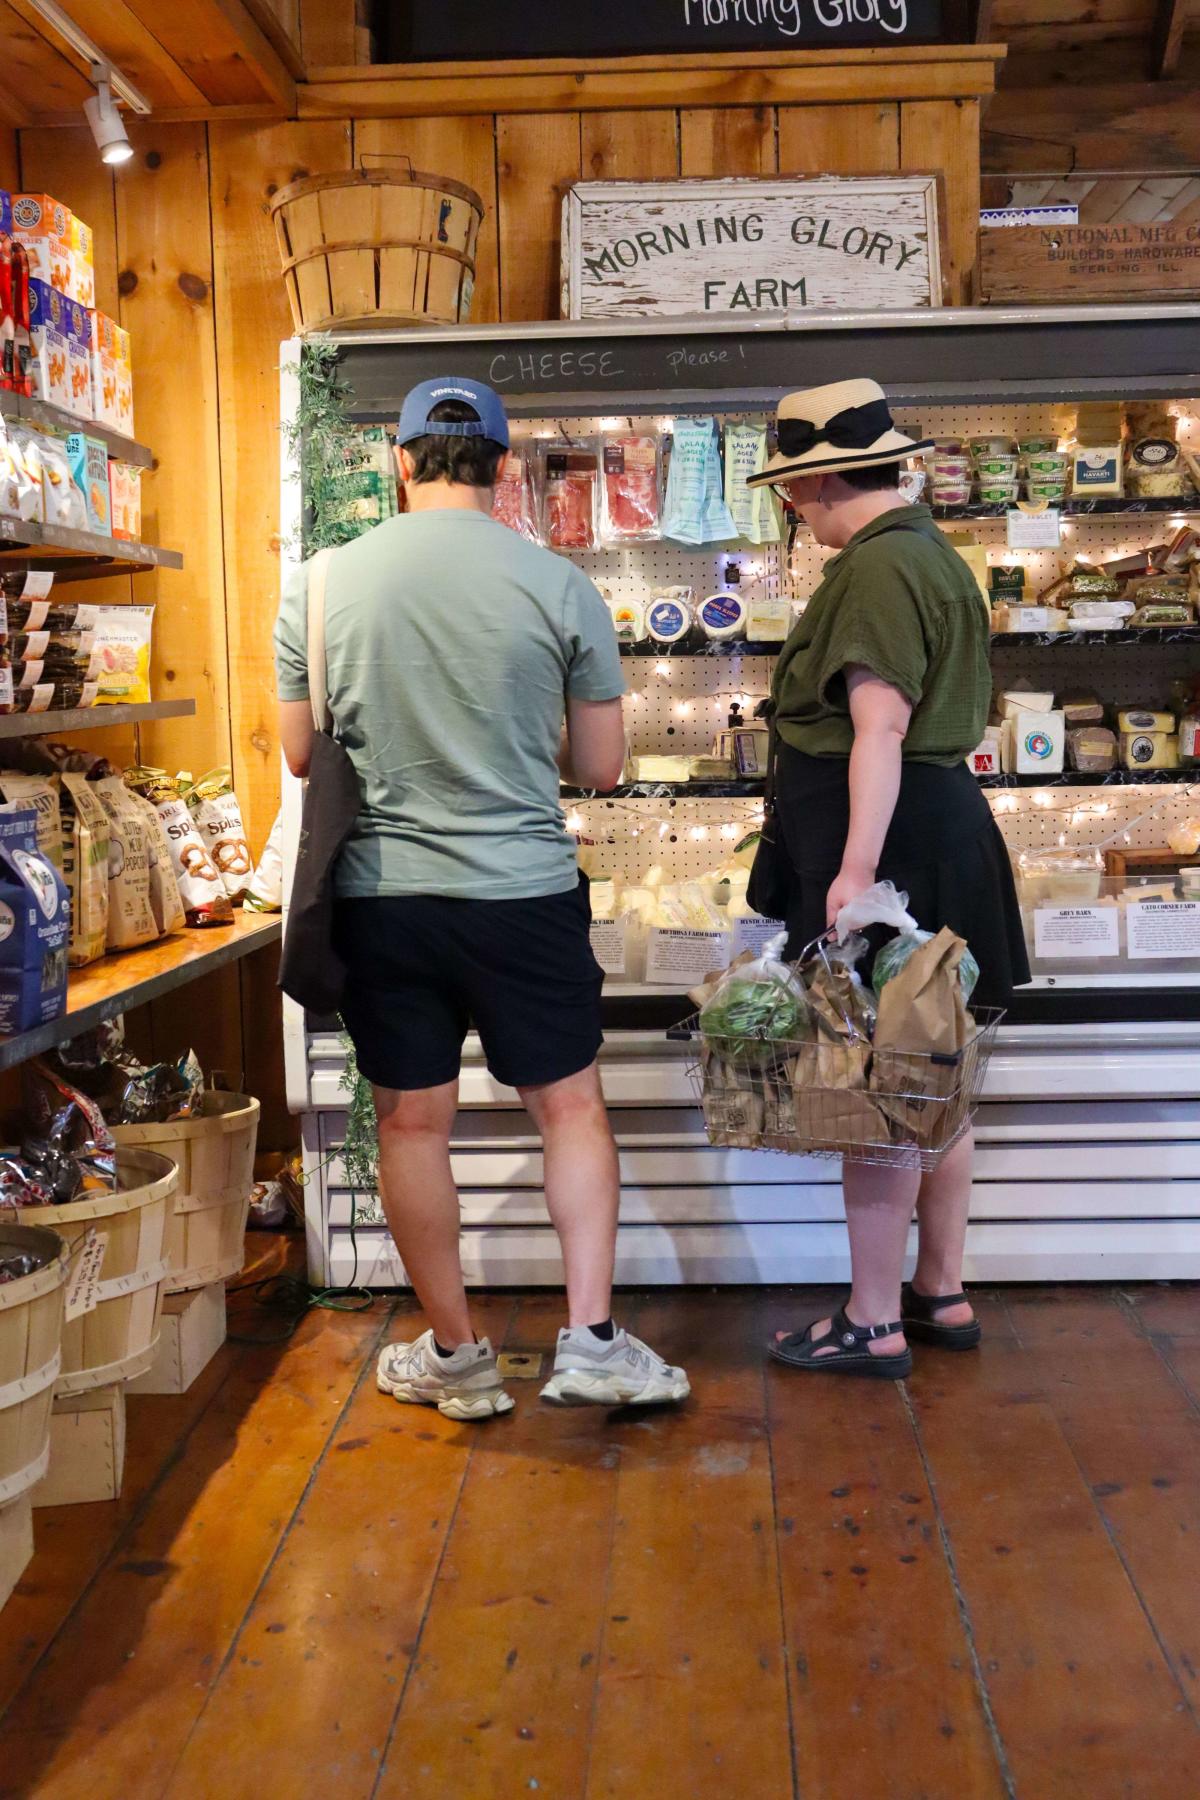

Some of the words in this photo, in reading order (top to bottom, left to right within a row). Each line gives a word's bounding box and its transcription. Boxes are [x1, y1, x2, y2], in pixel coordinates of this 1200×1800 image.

[814, 0, 908, 33] Glory
[584, 214, 764, 281] MORNING
[790, 216, 922, 271] GLORY
[1040, 228, 1133, 245] NATIONAL
[1139, 227, 1177, 243] MFG
[1186, 226, 1200, 241] C
[1047, 248, 1115, 262] BUILDERS
[1124, 246, 1200, 259] HARDWARE
[1157, 264, 1184, 273] ILL.
[704, 277, 807, 310] FARM
[488, 350, 625, 384] CHEESE
